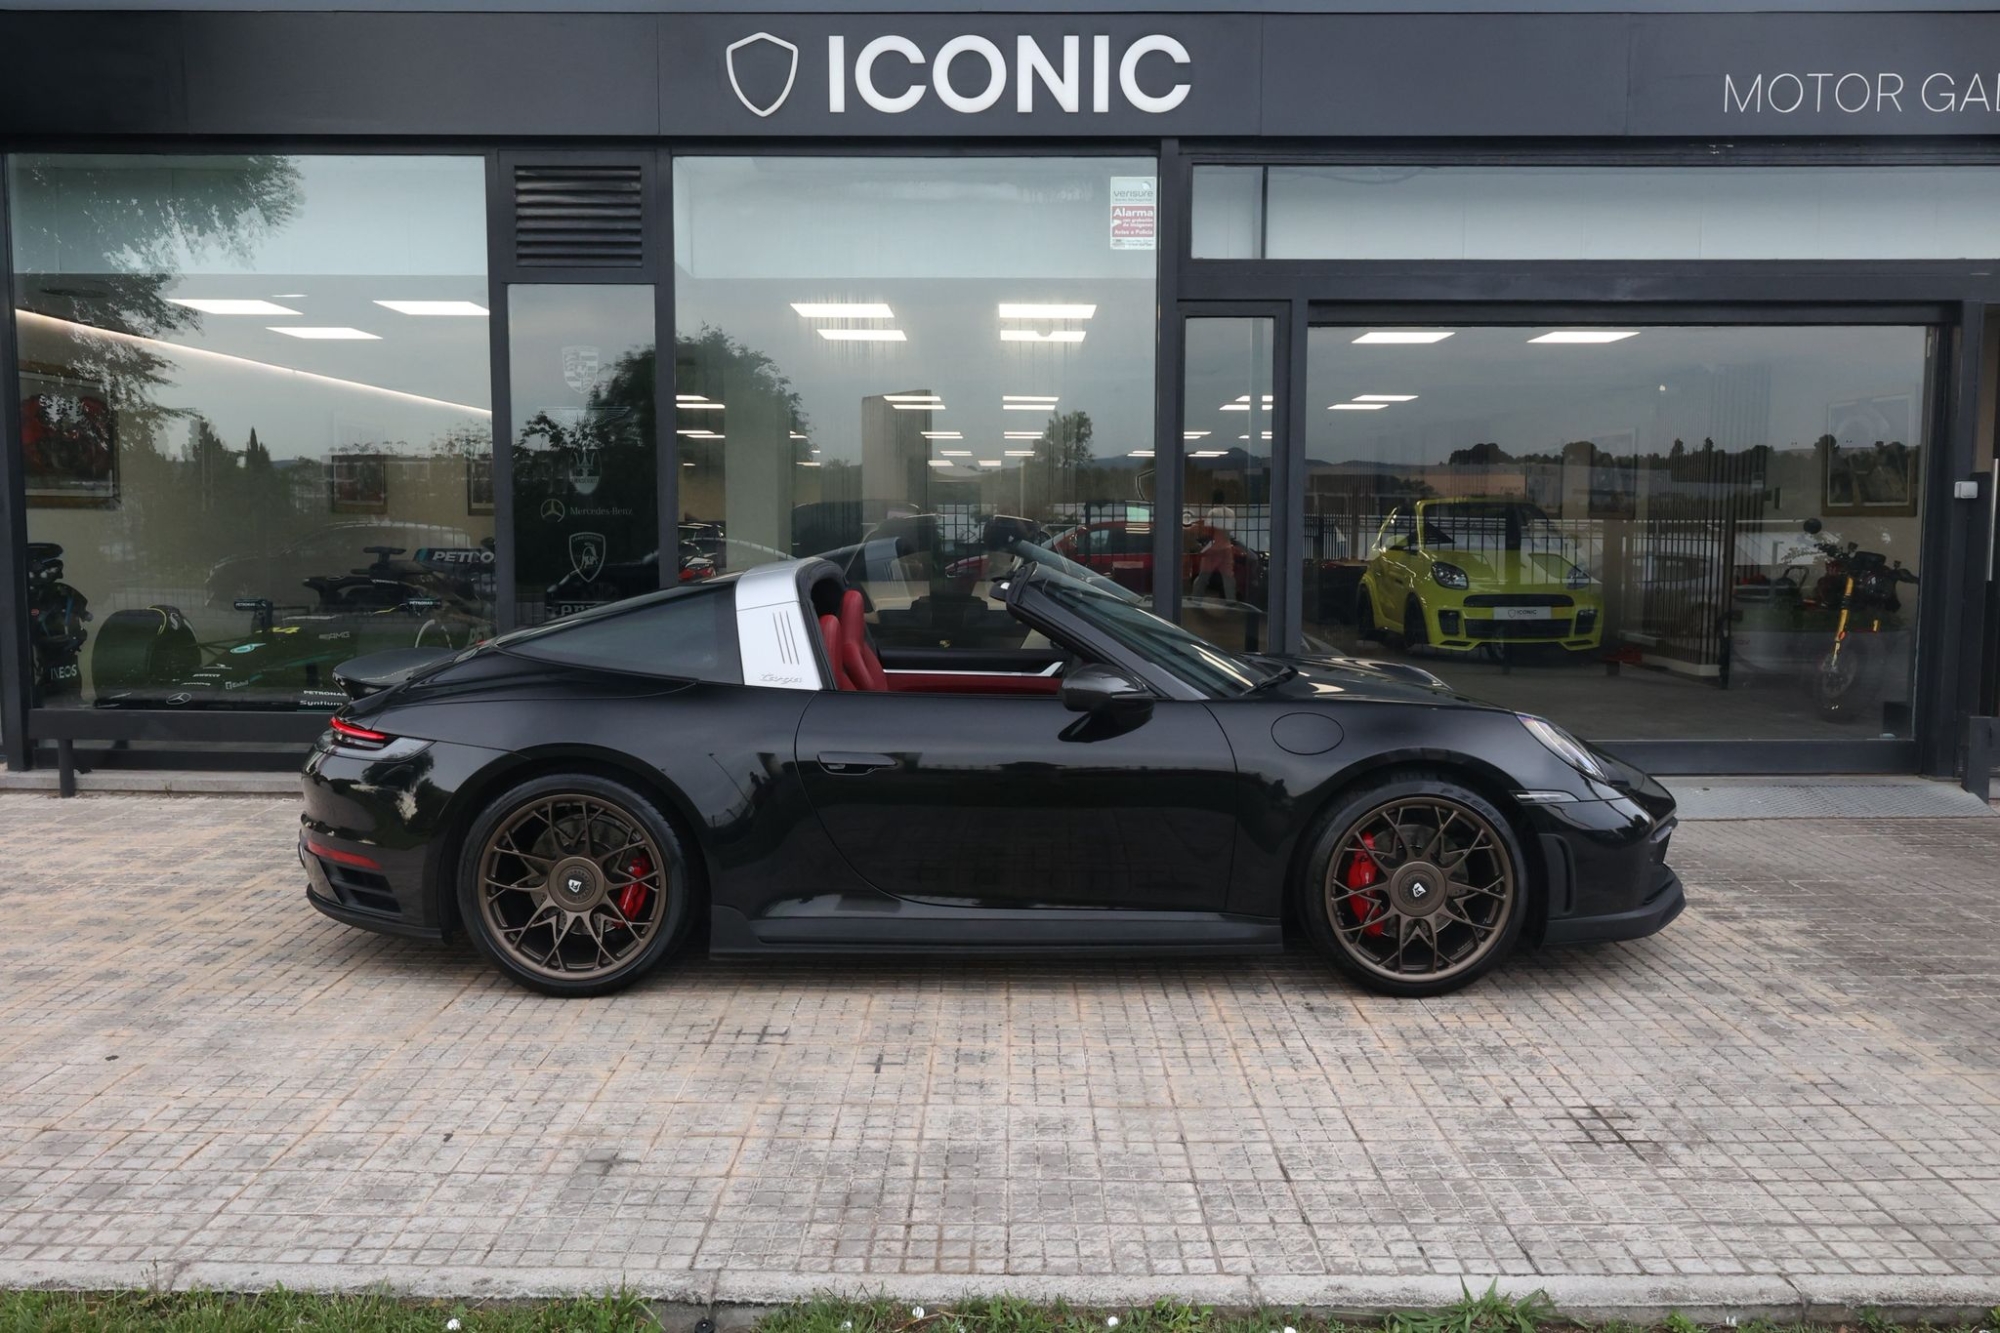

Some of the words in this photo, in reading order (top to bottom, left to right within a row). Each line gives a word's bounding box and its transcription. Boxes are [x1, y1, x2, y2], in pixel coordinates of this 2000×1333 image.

[828, 34, 1192, 114] ICONIC
[1724, 73, 1904, 113] MOTOR
[1921, 72, 2000, 113] GA
[1113, 190, 1154, 198] verisure
[1113, 207, 1154, 217] Alarma
[569, 506, 633, 516] Mercedes-Benz
[50, 664, 77, 680] INEOS
